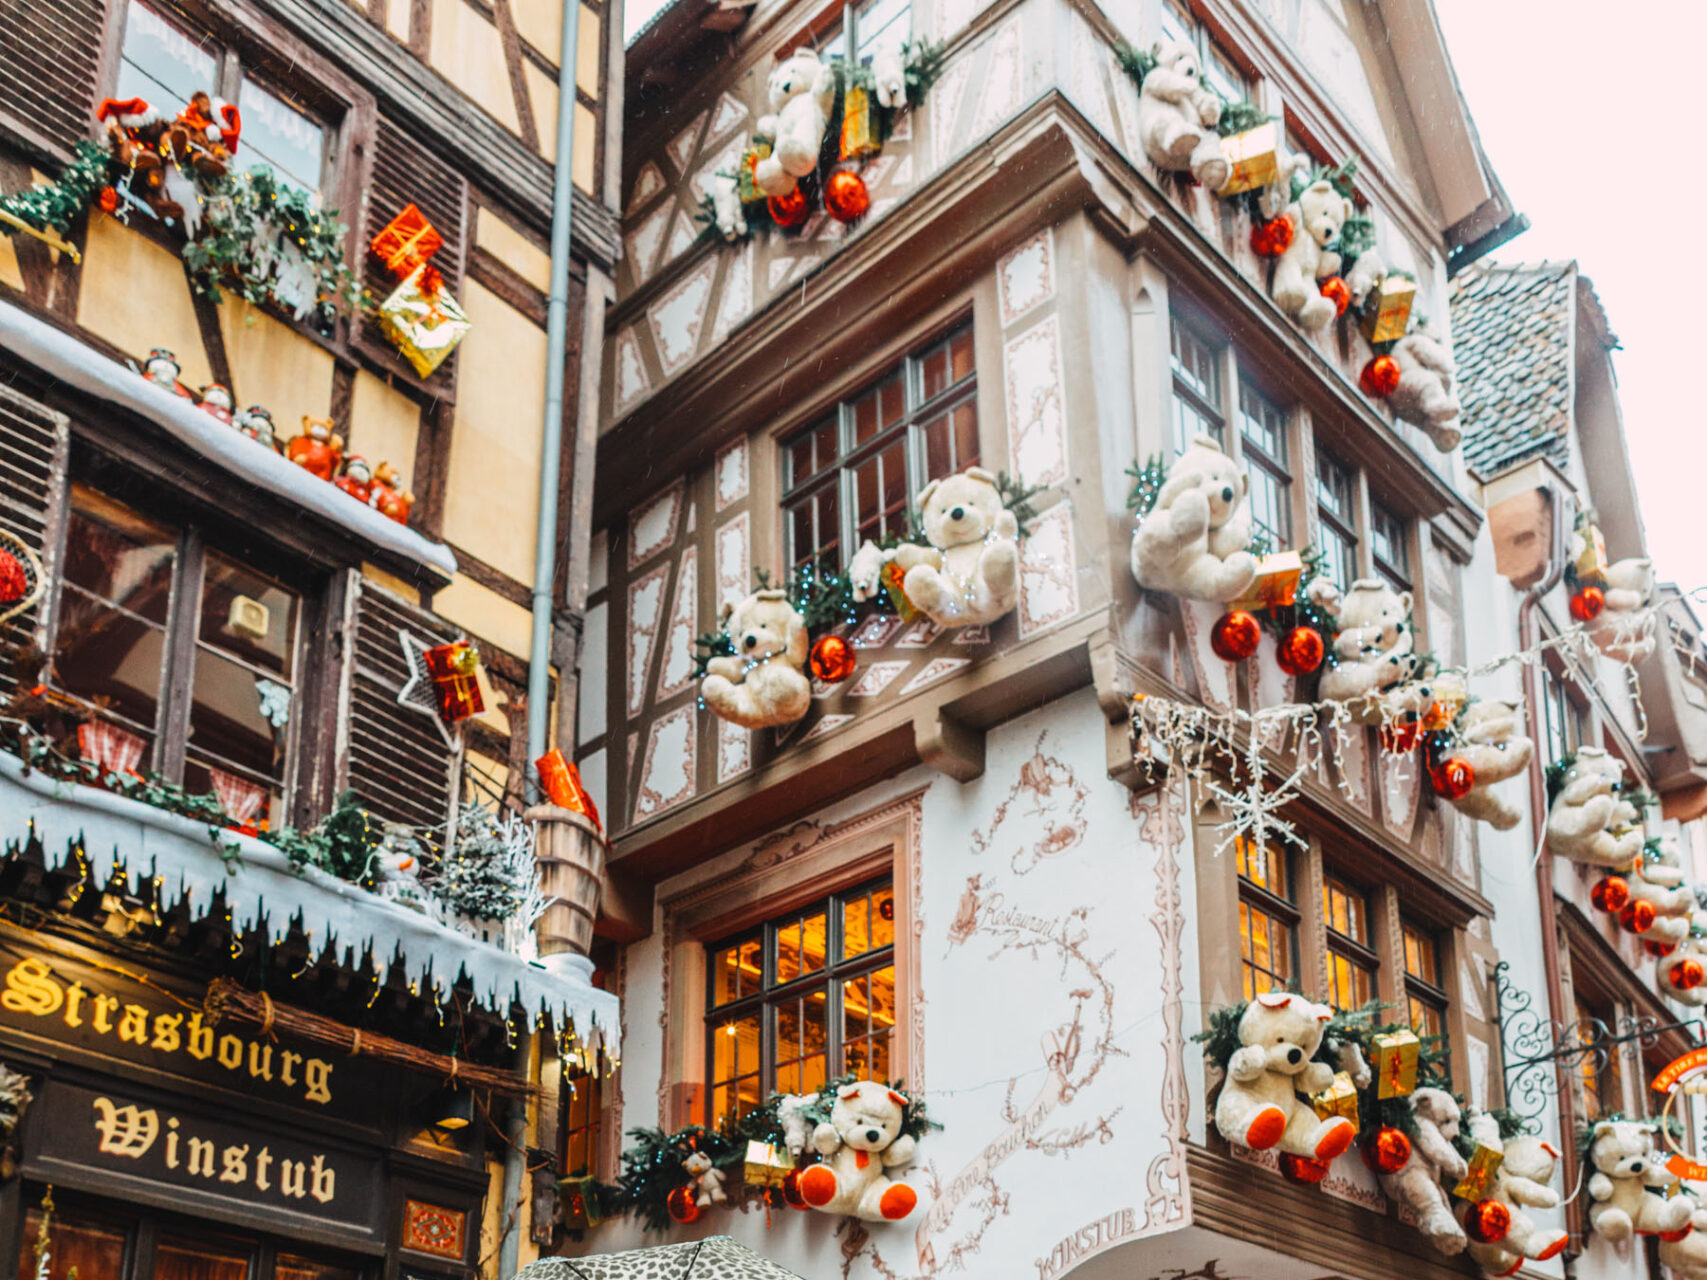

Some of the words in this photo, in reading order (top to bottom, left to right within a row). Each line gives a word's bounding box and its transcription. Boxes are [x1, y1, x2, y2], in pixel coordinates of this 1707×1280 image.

[978, 892, 1060, 938] Restaurant
[1, 956, 334, 1104] Strasbourg
[93, 1097, 336, 1203] Winstub
[983, 1101, 1049, 1169] Bouchon
